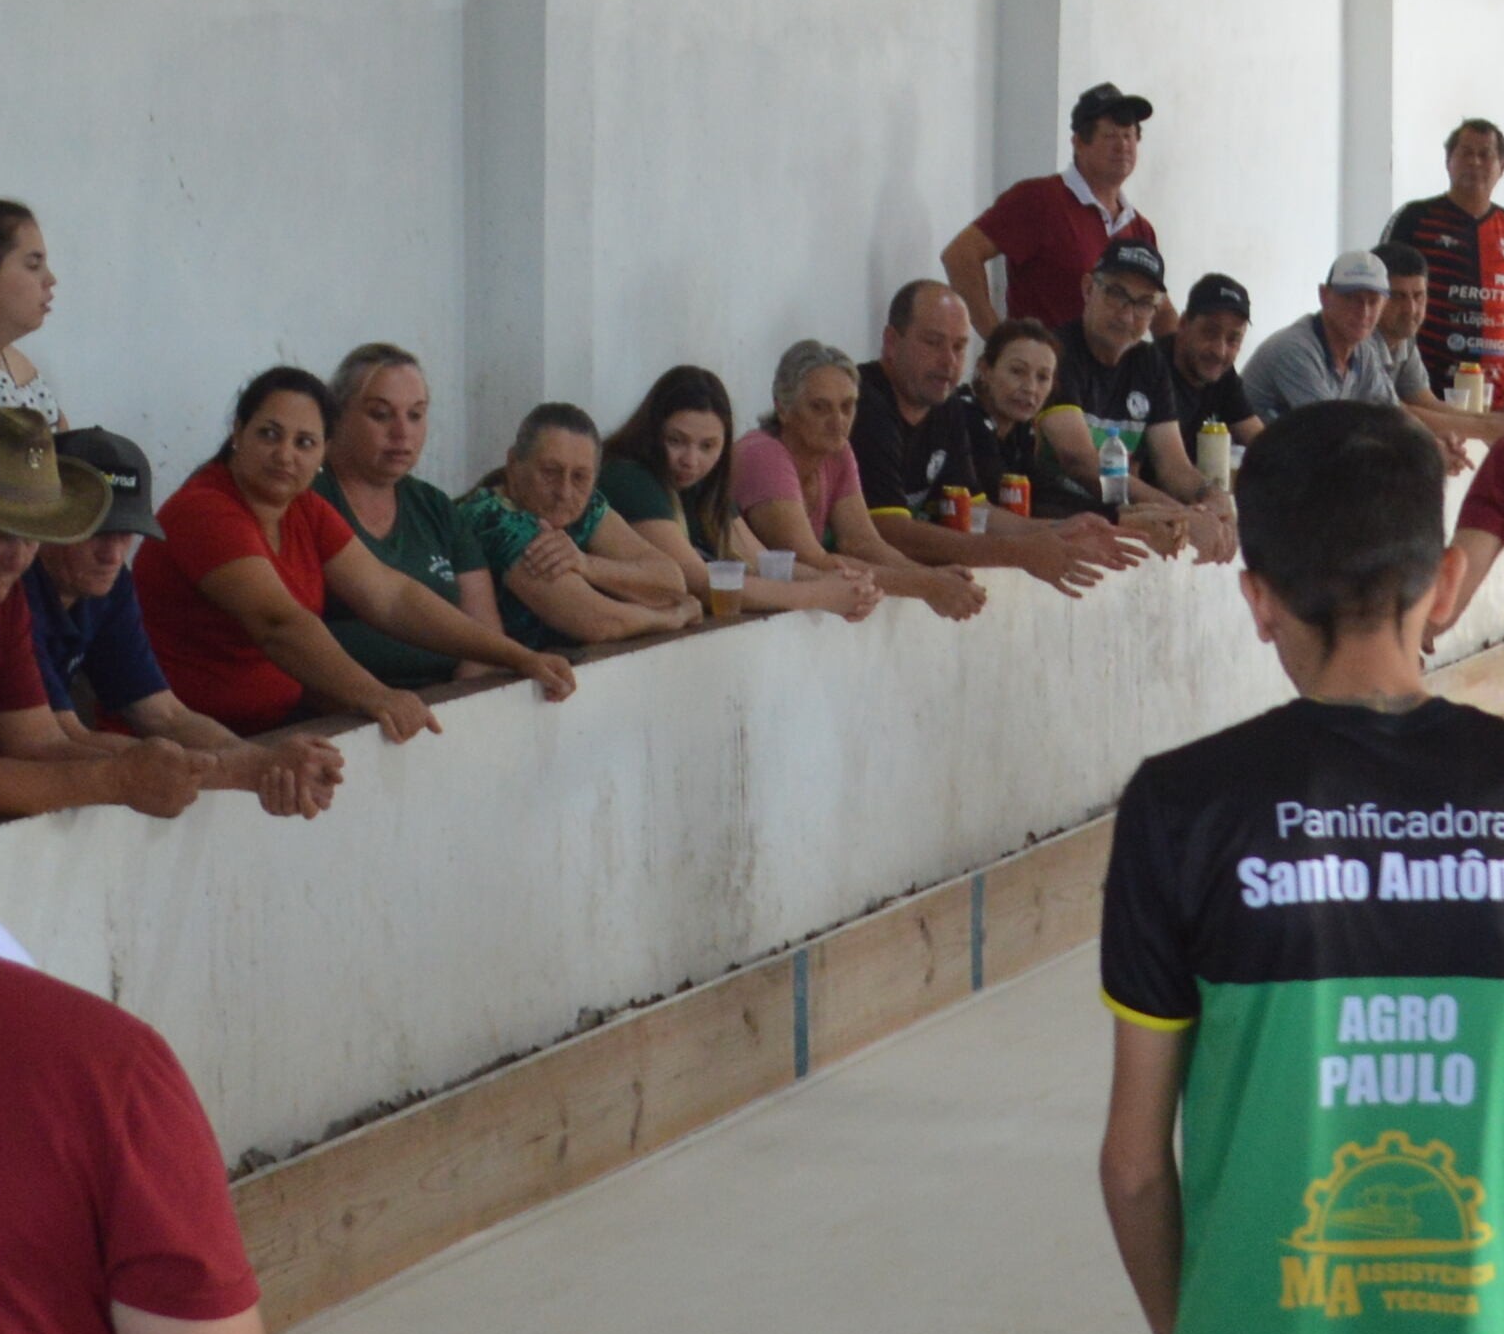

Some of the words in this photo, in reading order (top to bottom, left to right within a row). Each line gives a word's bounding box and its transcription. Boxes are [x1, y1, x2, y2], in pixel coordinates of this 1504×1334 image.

[1236, 854, 1370, 908] Santo
[1337, 993, 1459, 1044] AGRO
[1319, 1052, 1477, 1110] PAULO
